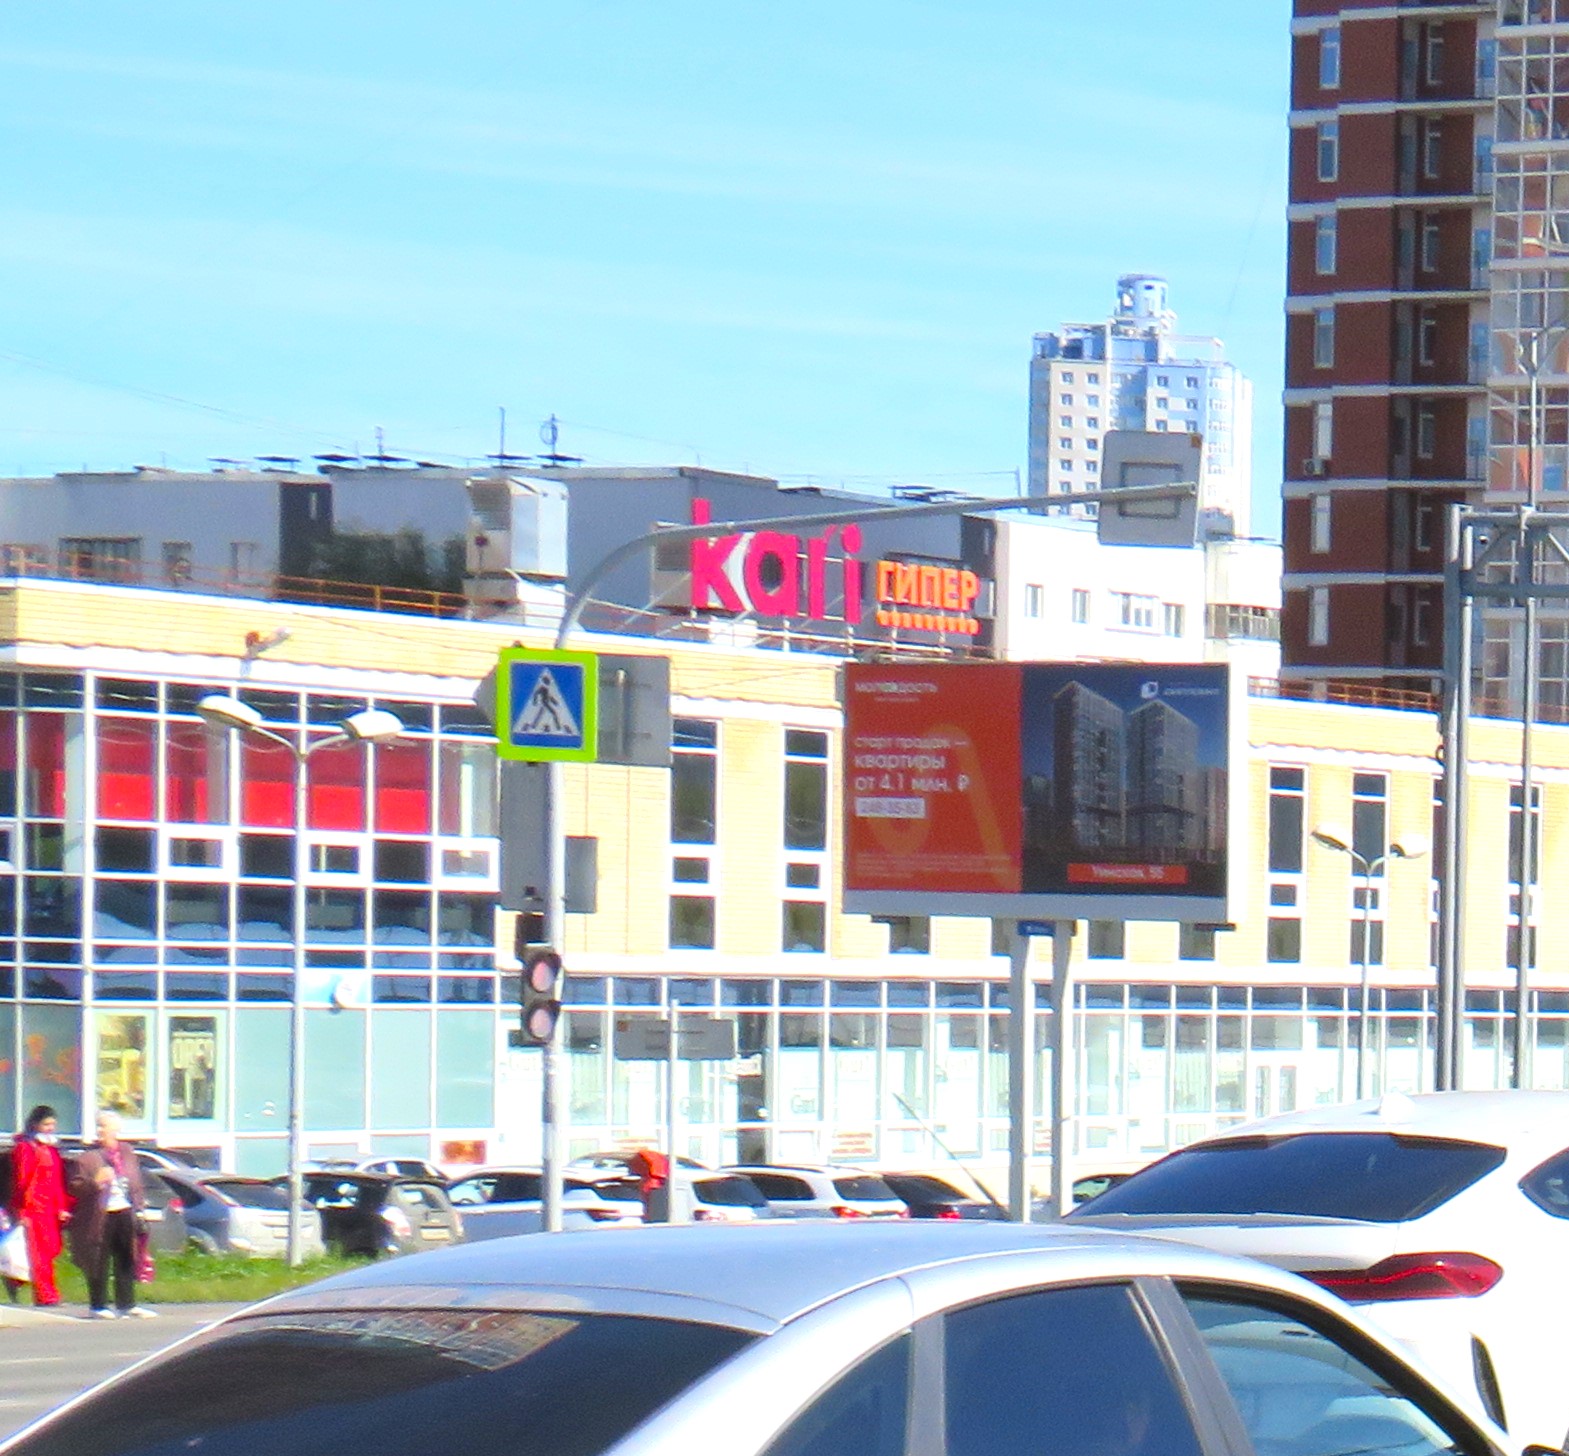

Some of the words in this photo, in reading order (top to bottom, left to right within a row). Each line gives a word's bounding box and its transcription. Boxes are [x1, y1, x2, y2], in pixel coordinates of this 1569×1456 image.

[691, 497, 862, 625] kari
[876, 559, 981, 612] ГИПЕР
[855, 754, 946, 772] квартиры
